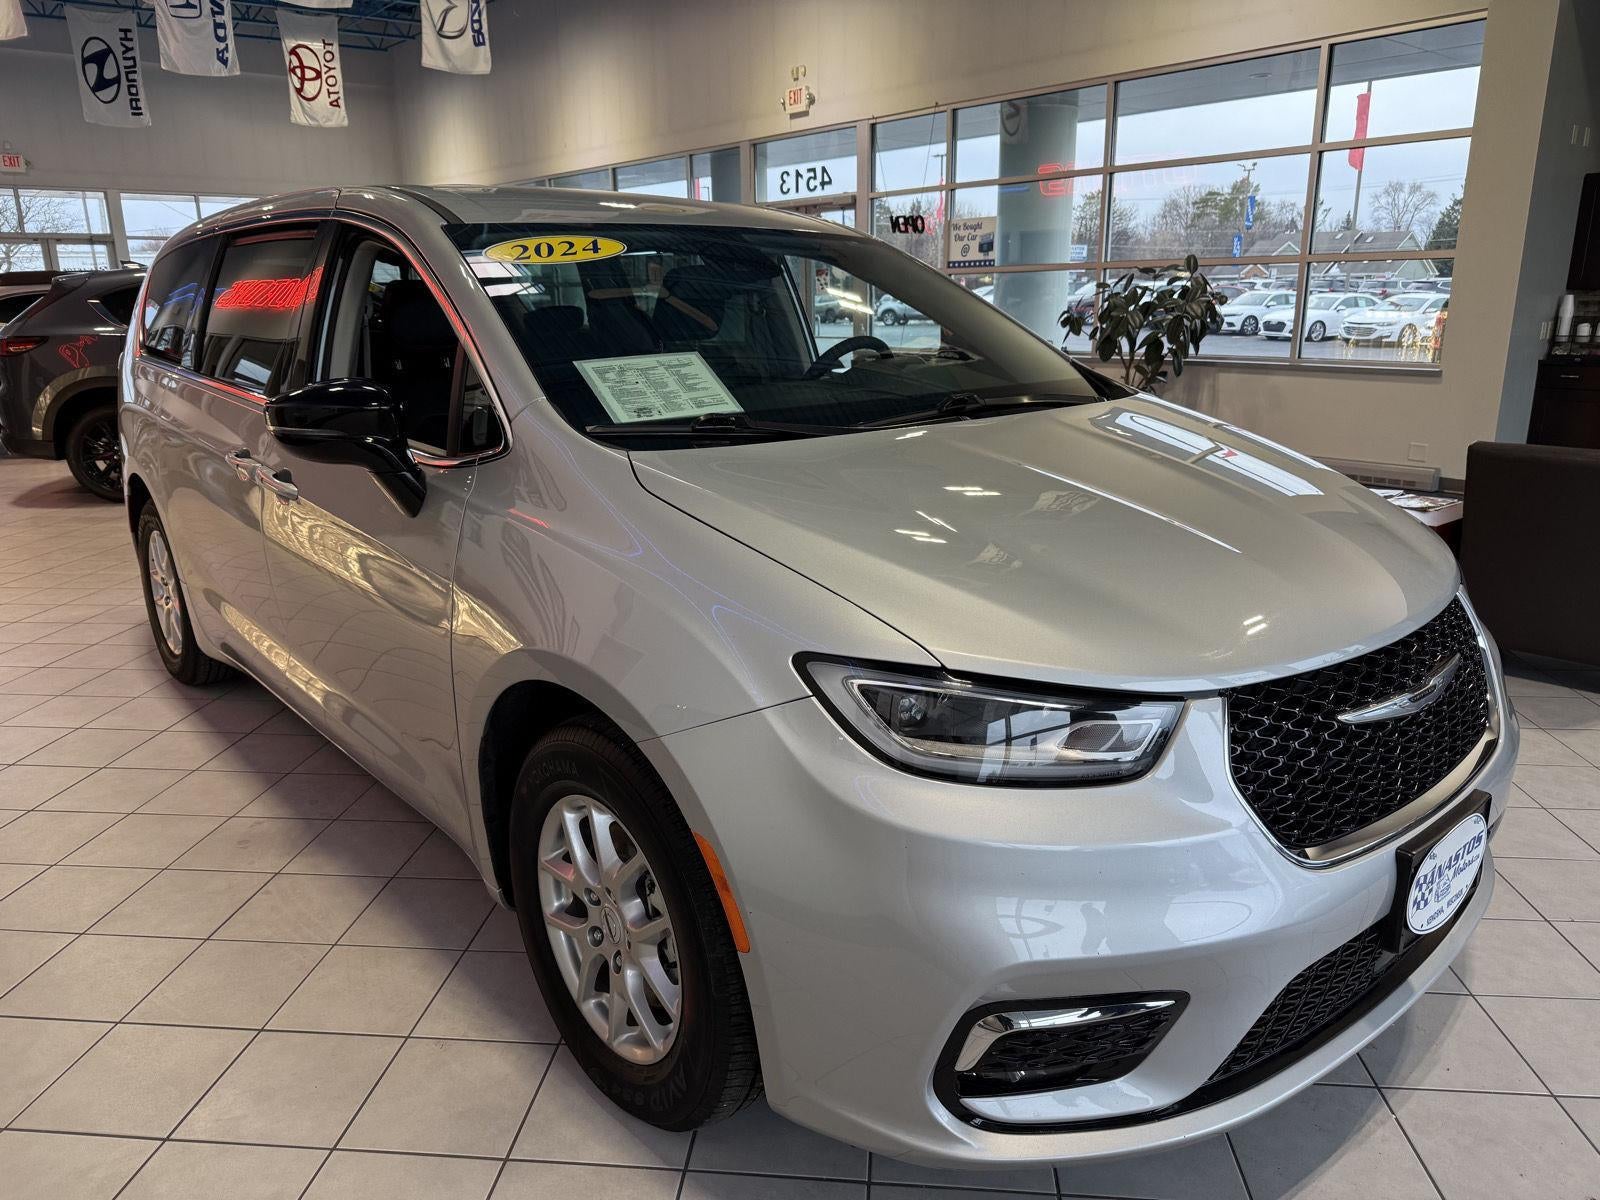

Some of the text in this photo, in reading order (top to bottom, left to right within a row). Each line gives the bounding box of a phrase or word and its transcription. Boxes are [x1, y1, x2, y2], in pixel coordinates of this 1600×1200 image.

[789, 88, 803, 106] EXIT
[2, 155, 20, 168] EXIT
[963, 221, 983, 233] Bought
[967, 232, 978, 241] Car
[510, 238, 602, 261] 2024
